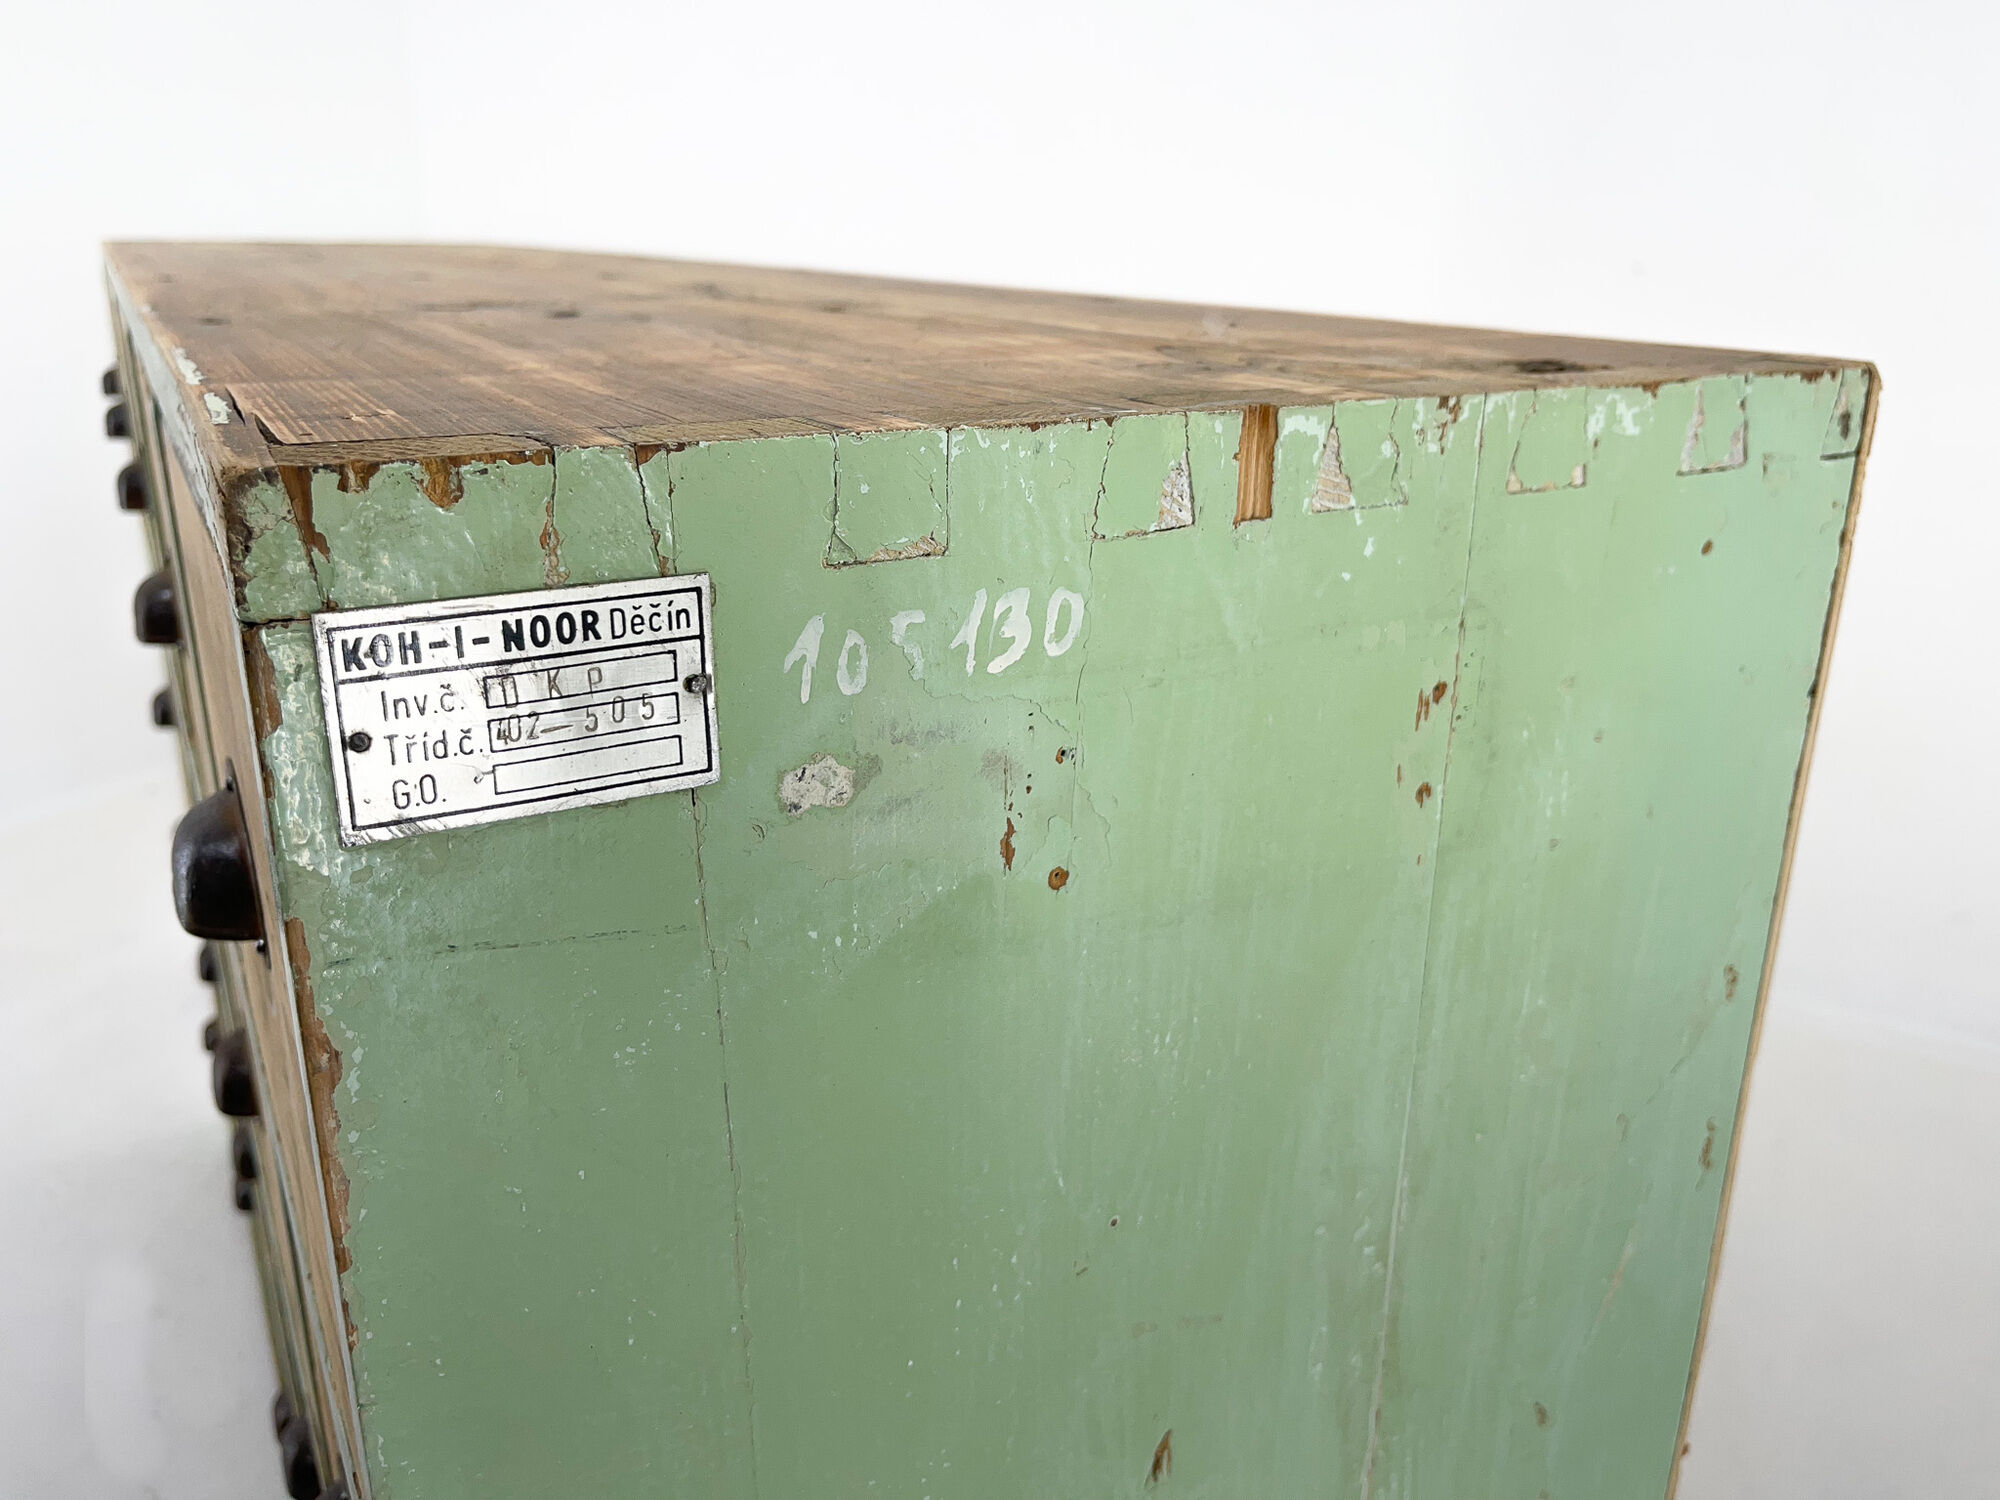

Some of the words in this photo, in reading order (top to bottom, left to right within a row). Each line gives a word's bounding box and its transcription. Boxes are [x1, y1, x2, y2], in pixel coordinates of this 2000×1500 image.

[341, 609, 603, 672] KOH-I-NOOR
[610, 600, 692, 640] Děčín
[949, 586, 1085, 678] 130
[380, 683, 464, 722] Inv.č.
[384, 728, 484, 766] Tříd.č.
